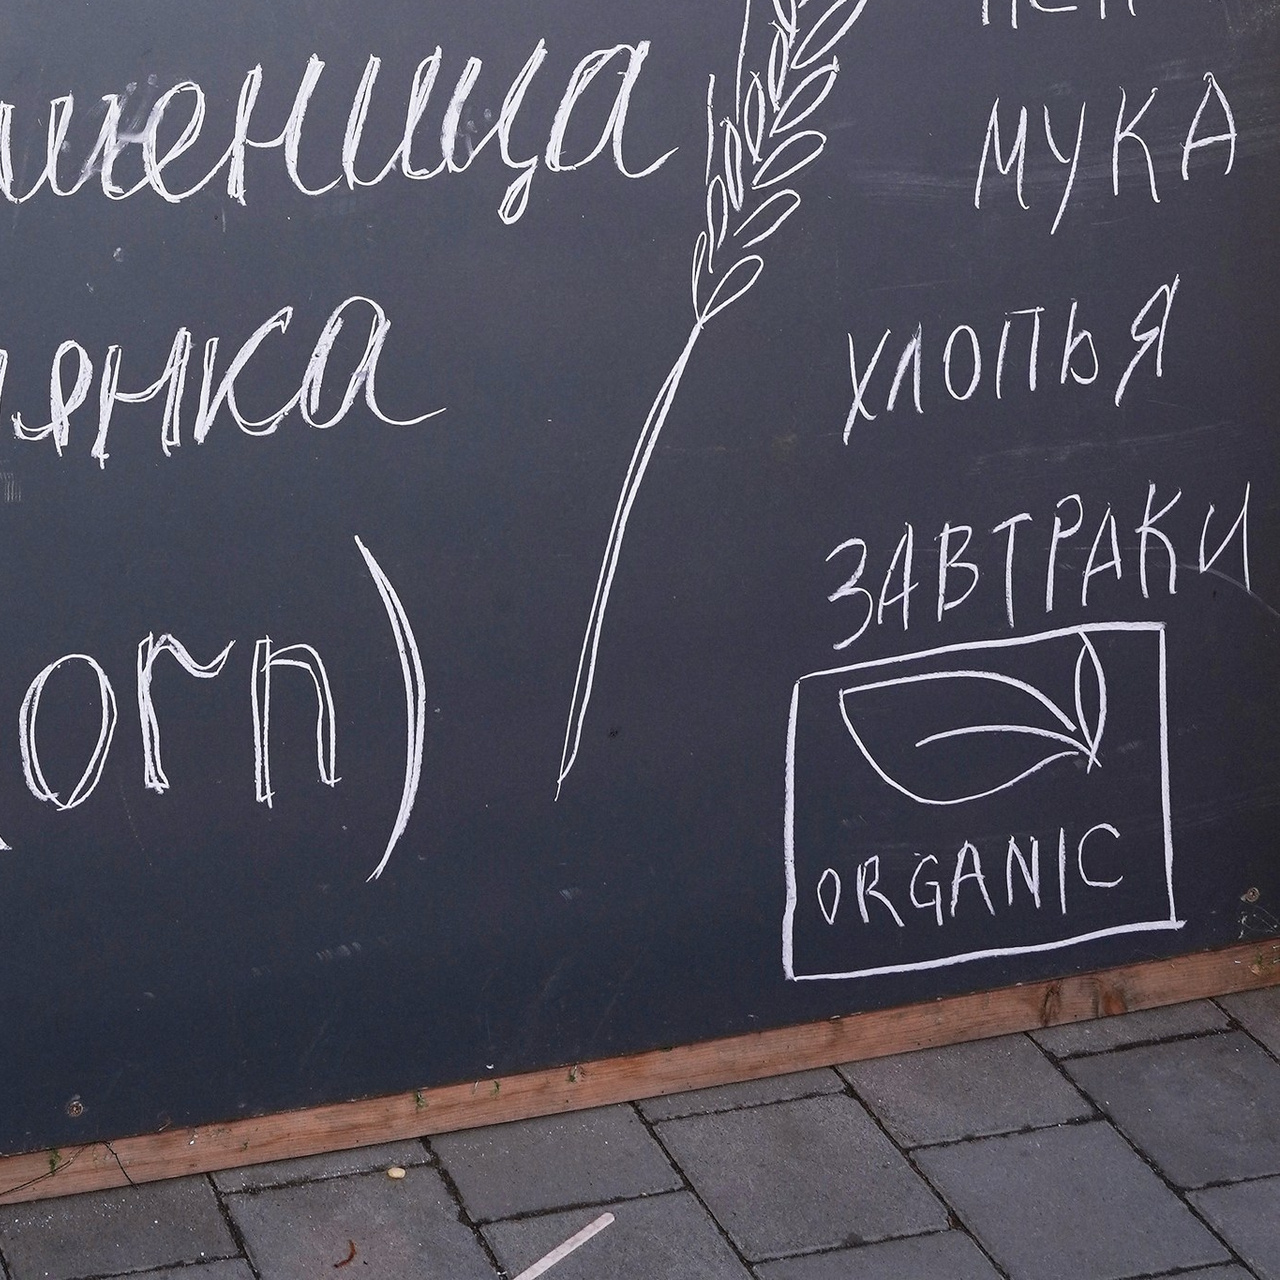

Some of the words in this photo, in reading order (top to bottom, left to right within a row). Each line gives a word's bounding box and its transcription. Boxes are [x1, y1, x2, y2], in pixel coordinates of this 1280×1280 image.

[974, 71, 1238, 236] МУКА
[842, 273, 1181, 446] ХЛОПЬЯ
[825, 479, 1252, 650] ЗАВТРАКИ
[816, 822, 1124, 928] ORGANIC
